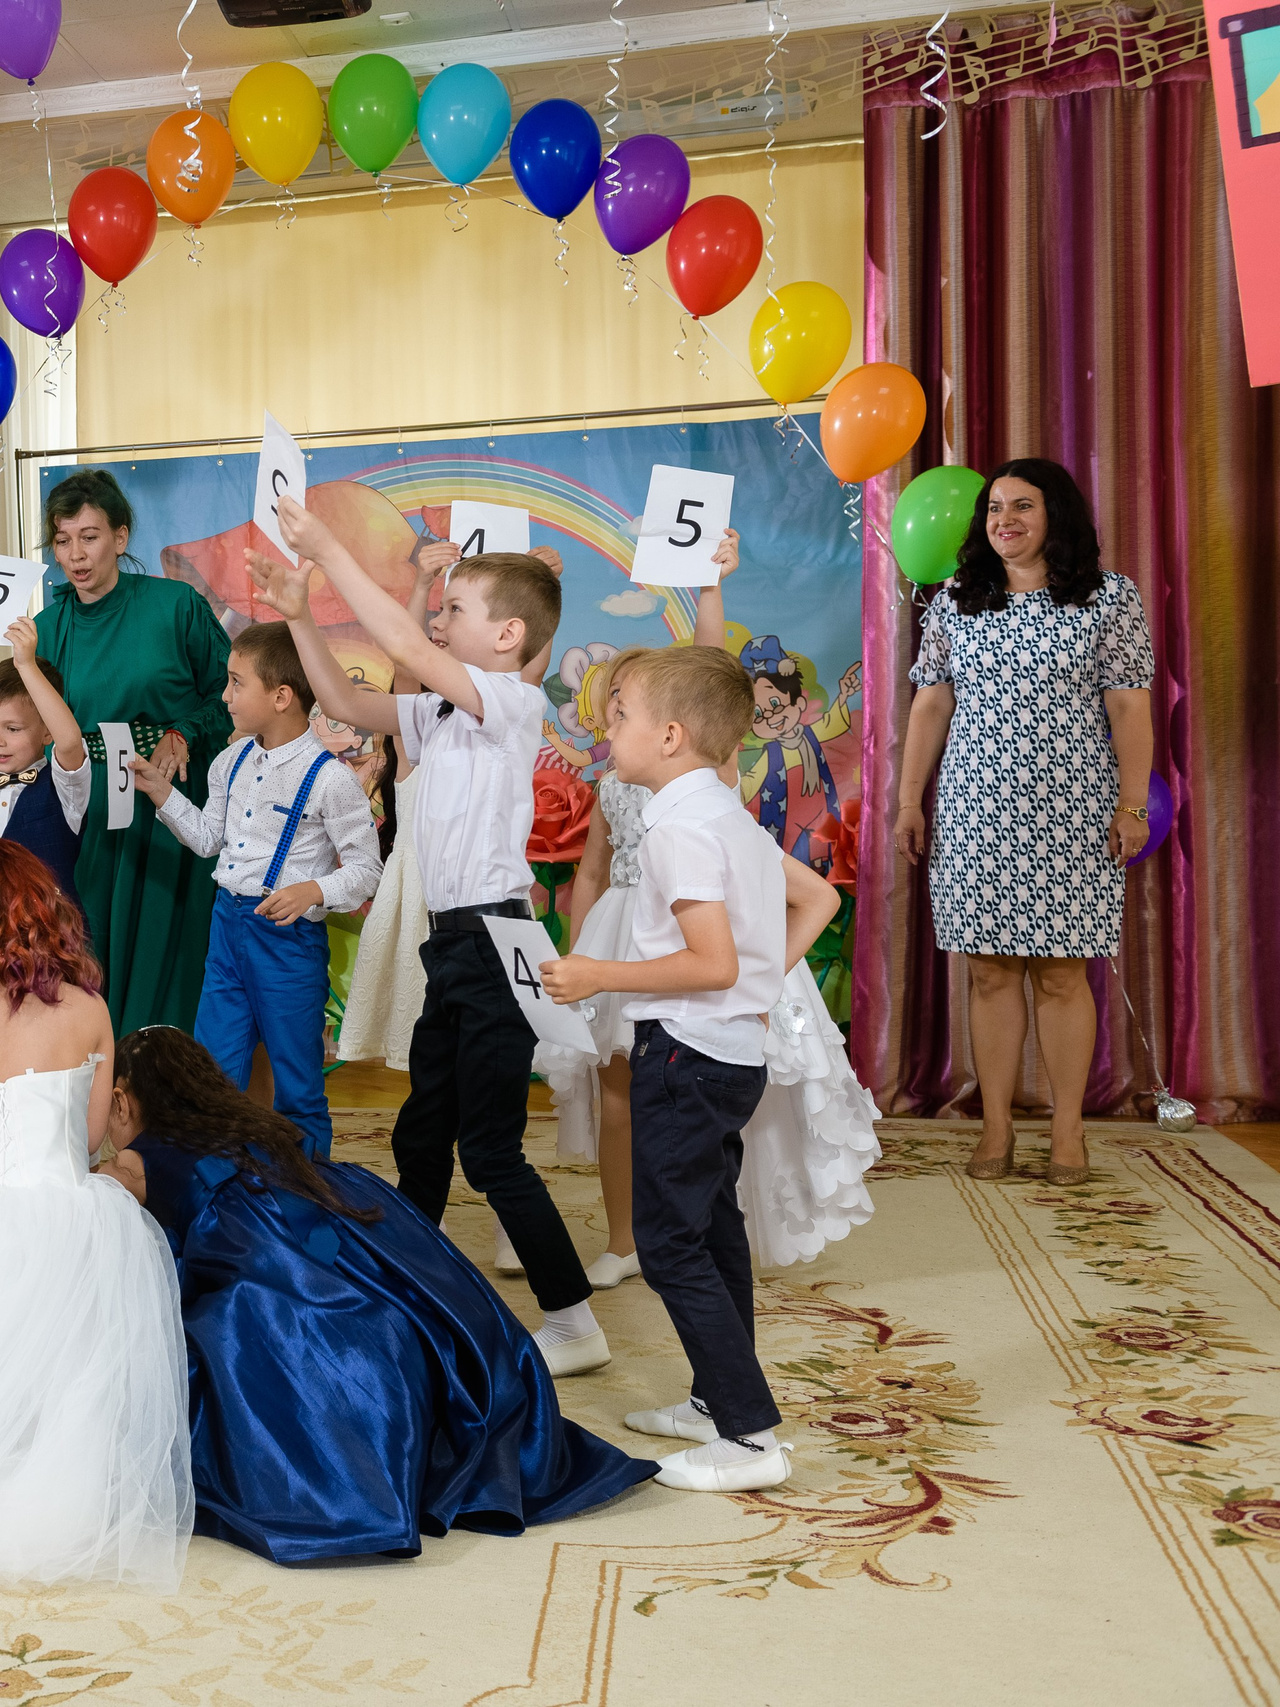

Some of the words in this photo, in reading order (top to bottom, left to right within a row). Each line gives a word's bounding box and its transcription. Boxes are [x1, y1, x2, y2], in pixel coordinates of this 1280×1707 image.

[668, 498, 705, 548] 5
[118, 749, 130, 793] 5
[513, 946, 542, 1000] 4
